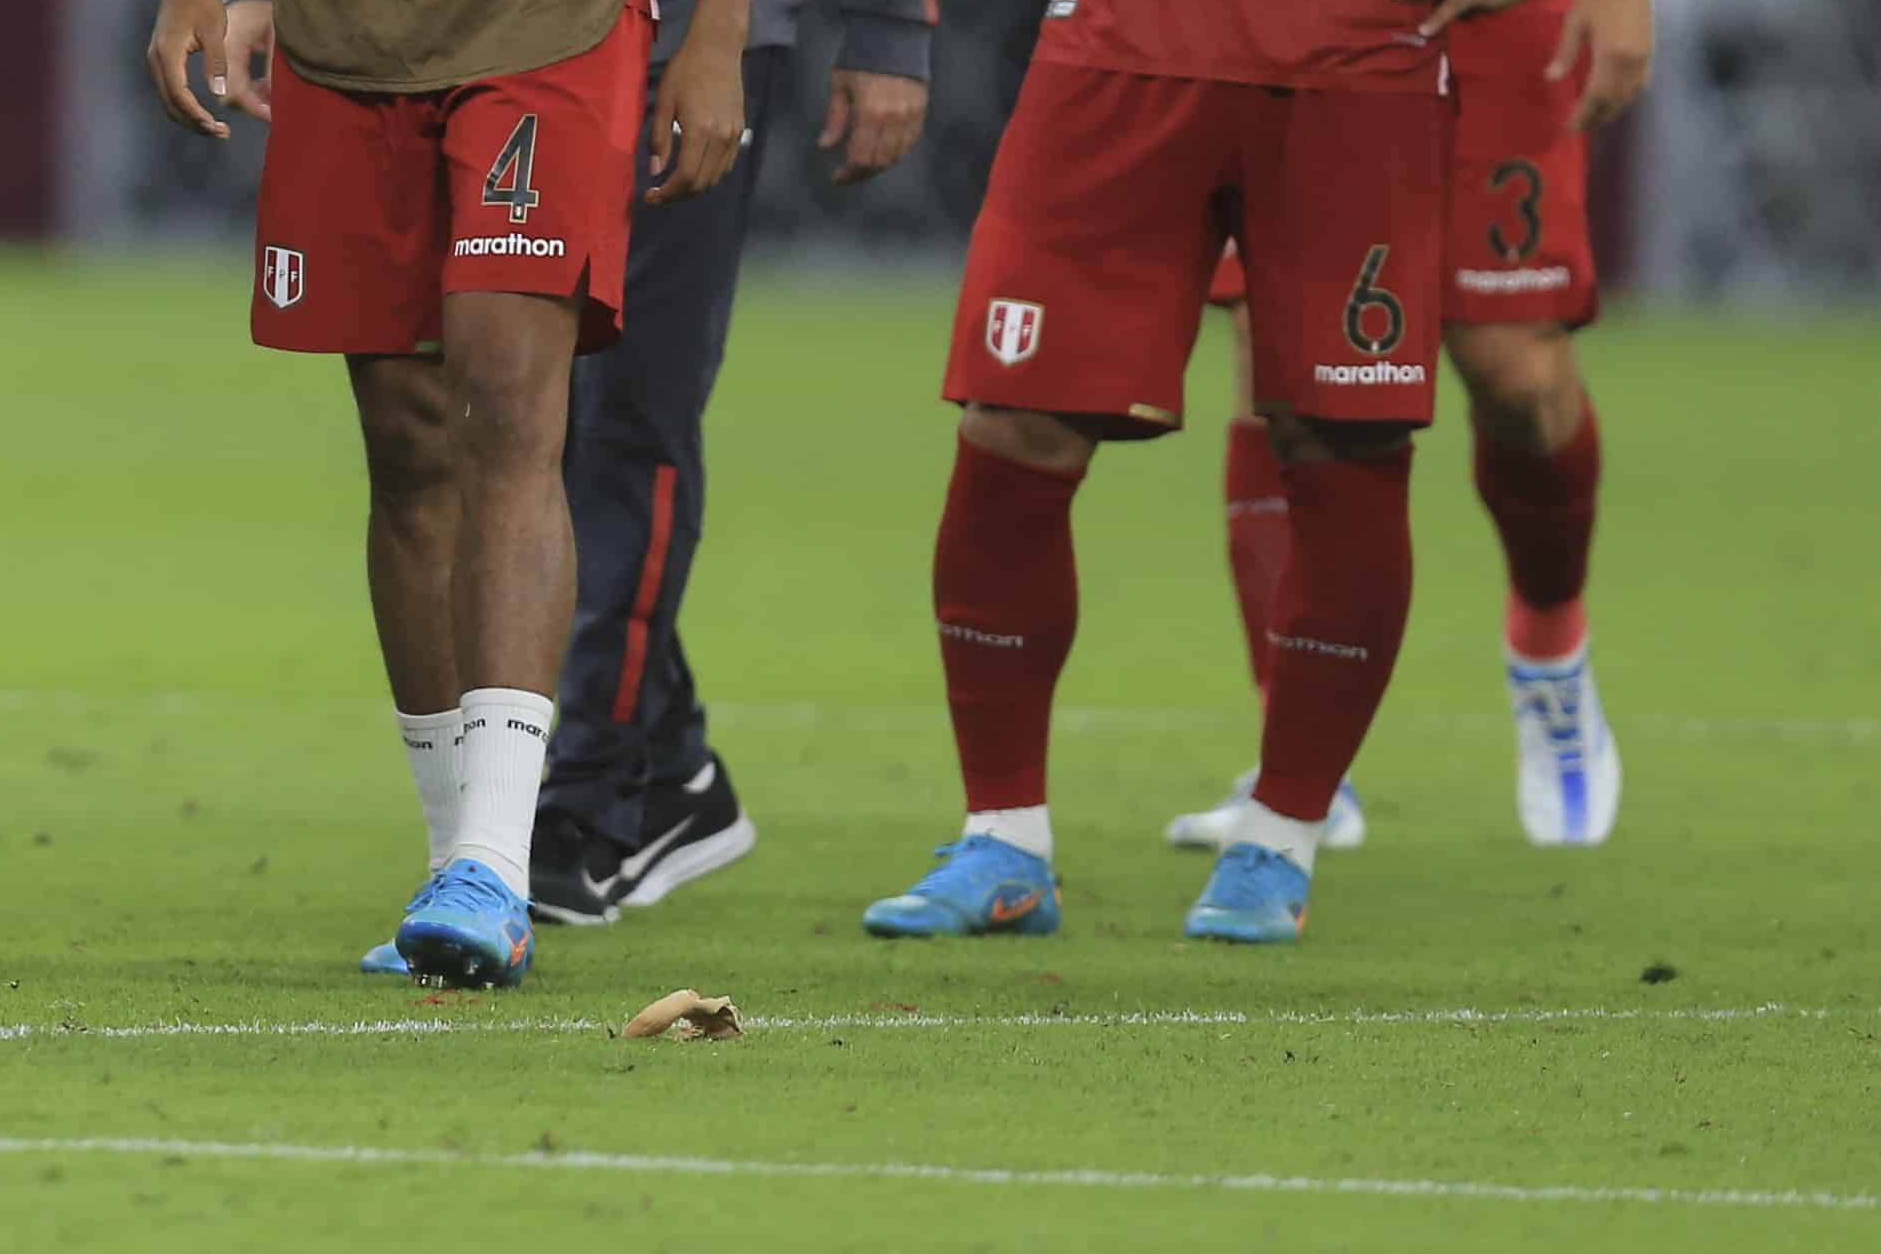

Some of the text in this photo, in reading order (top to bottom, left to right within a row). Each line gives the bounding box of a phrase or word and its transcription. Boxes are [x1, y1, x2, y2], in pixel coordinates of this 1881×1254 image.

[482, 114, 538, 223] 4
[1488, 157, 1543, 262] 3
[455, 233, 566, 257] marathon
[1343, 245, 1405, 354] 6
[1315, 361, 1425, 385] marathon
